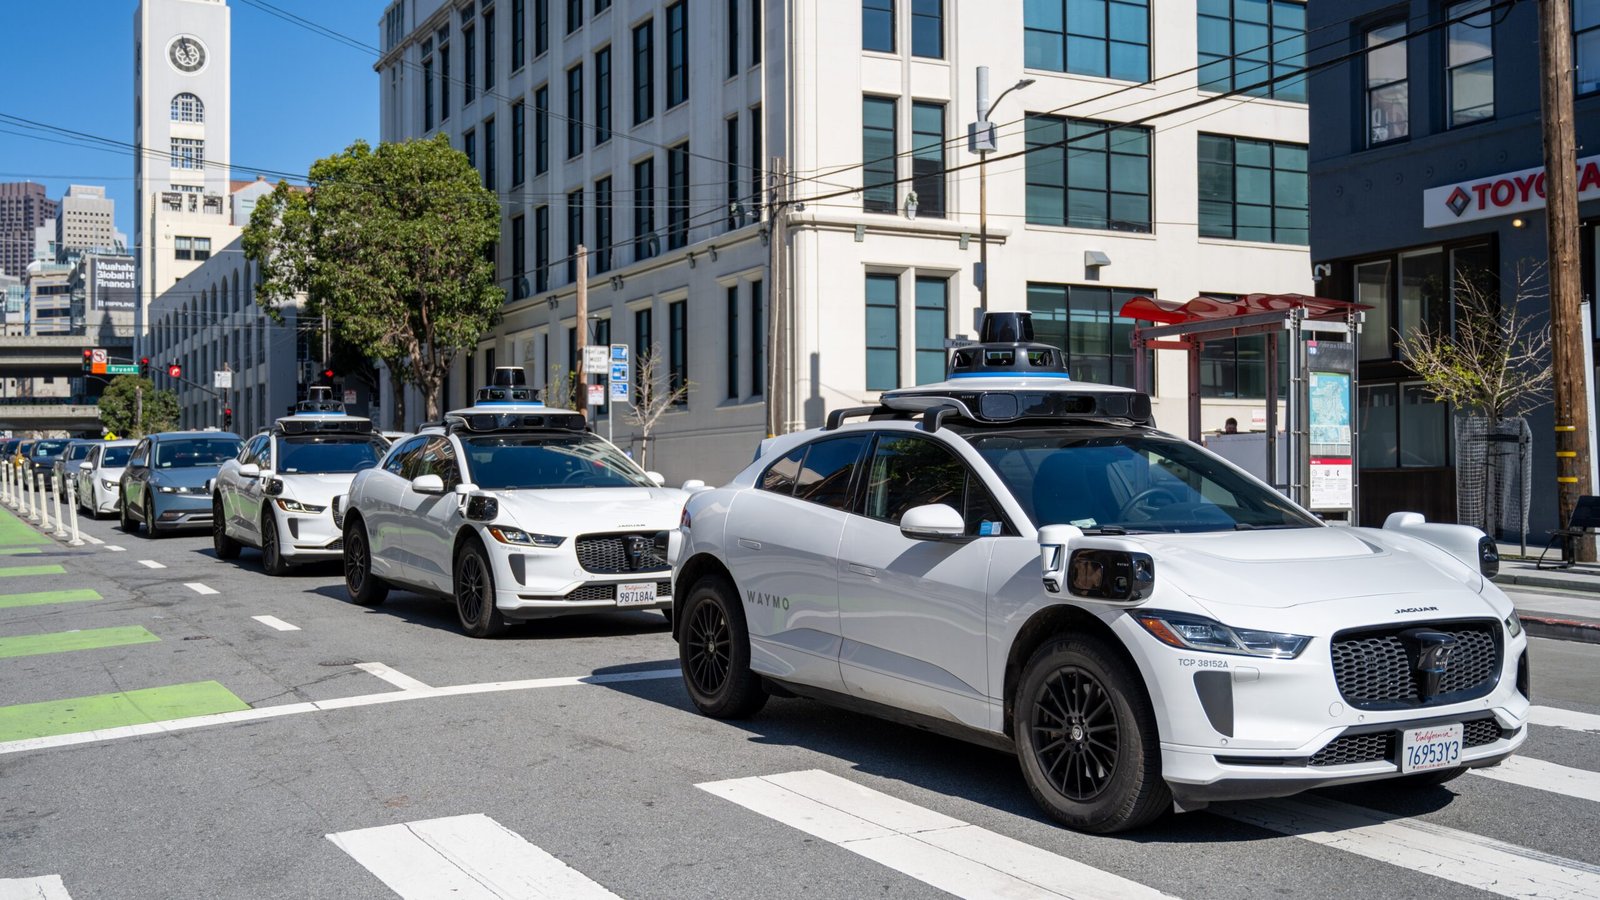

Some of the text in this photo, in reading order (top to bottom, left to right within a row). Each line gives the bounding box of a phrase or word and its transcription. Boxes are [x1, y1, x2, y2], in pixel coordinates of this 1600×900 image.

[1472, 162, 1600, 210] TOYA
[97, 271, 125, 279] Global
[619, 591, 654, 603] 98718A4
[746, 590, 790, 611] WAYMO
[1394, 606, 1439, 614] JAGUAR
[1178, 658, 1229, 668] TCP 38152A
[1415, 730, 1452, 743] California
[1407, 740, 1459, 766] 76953Y3
